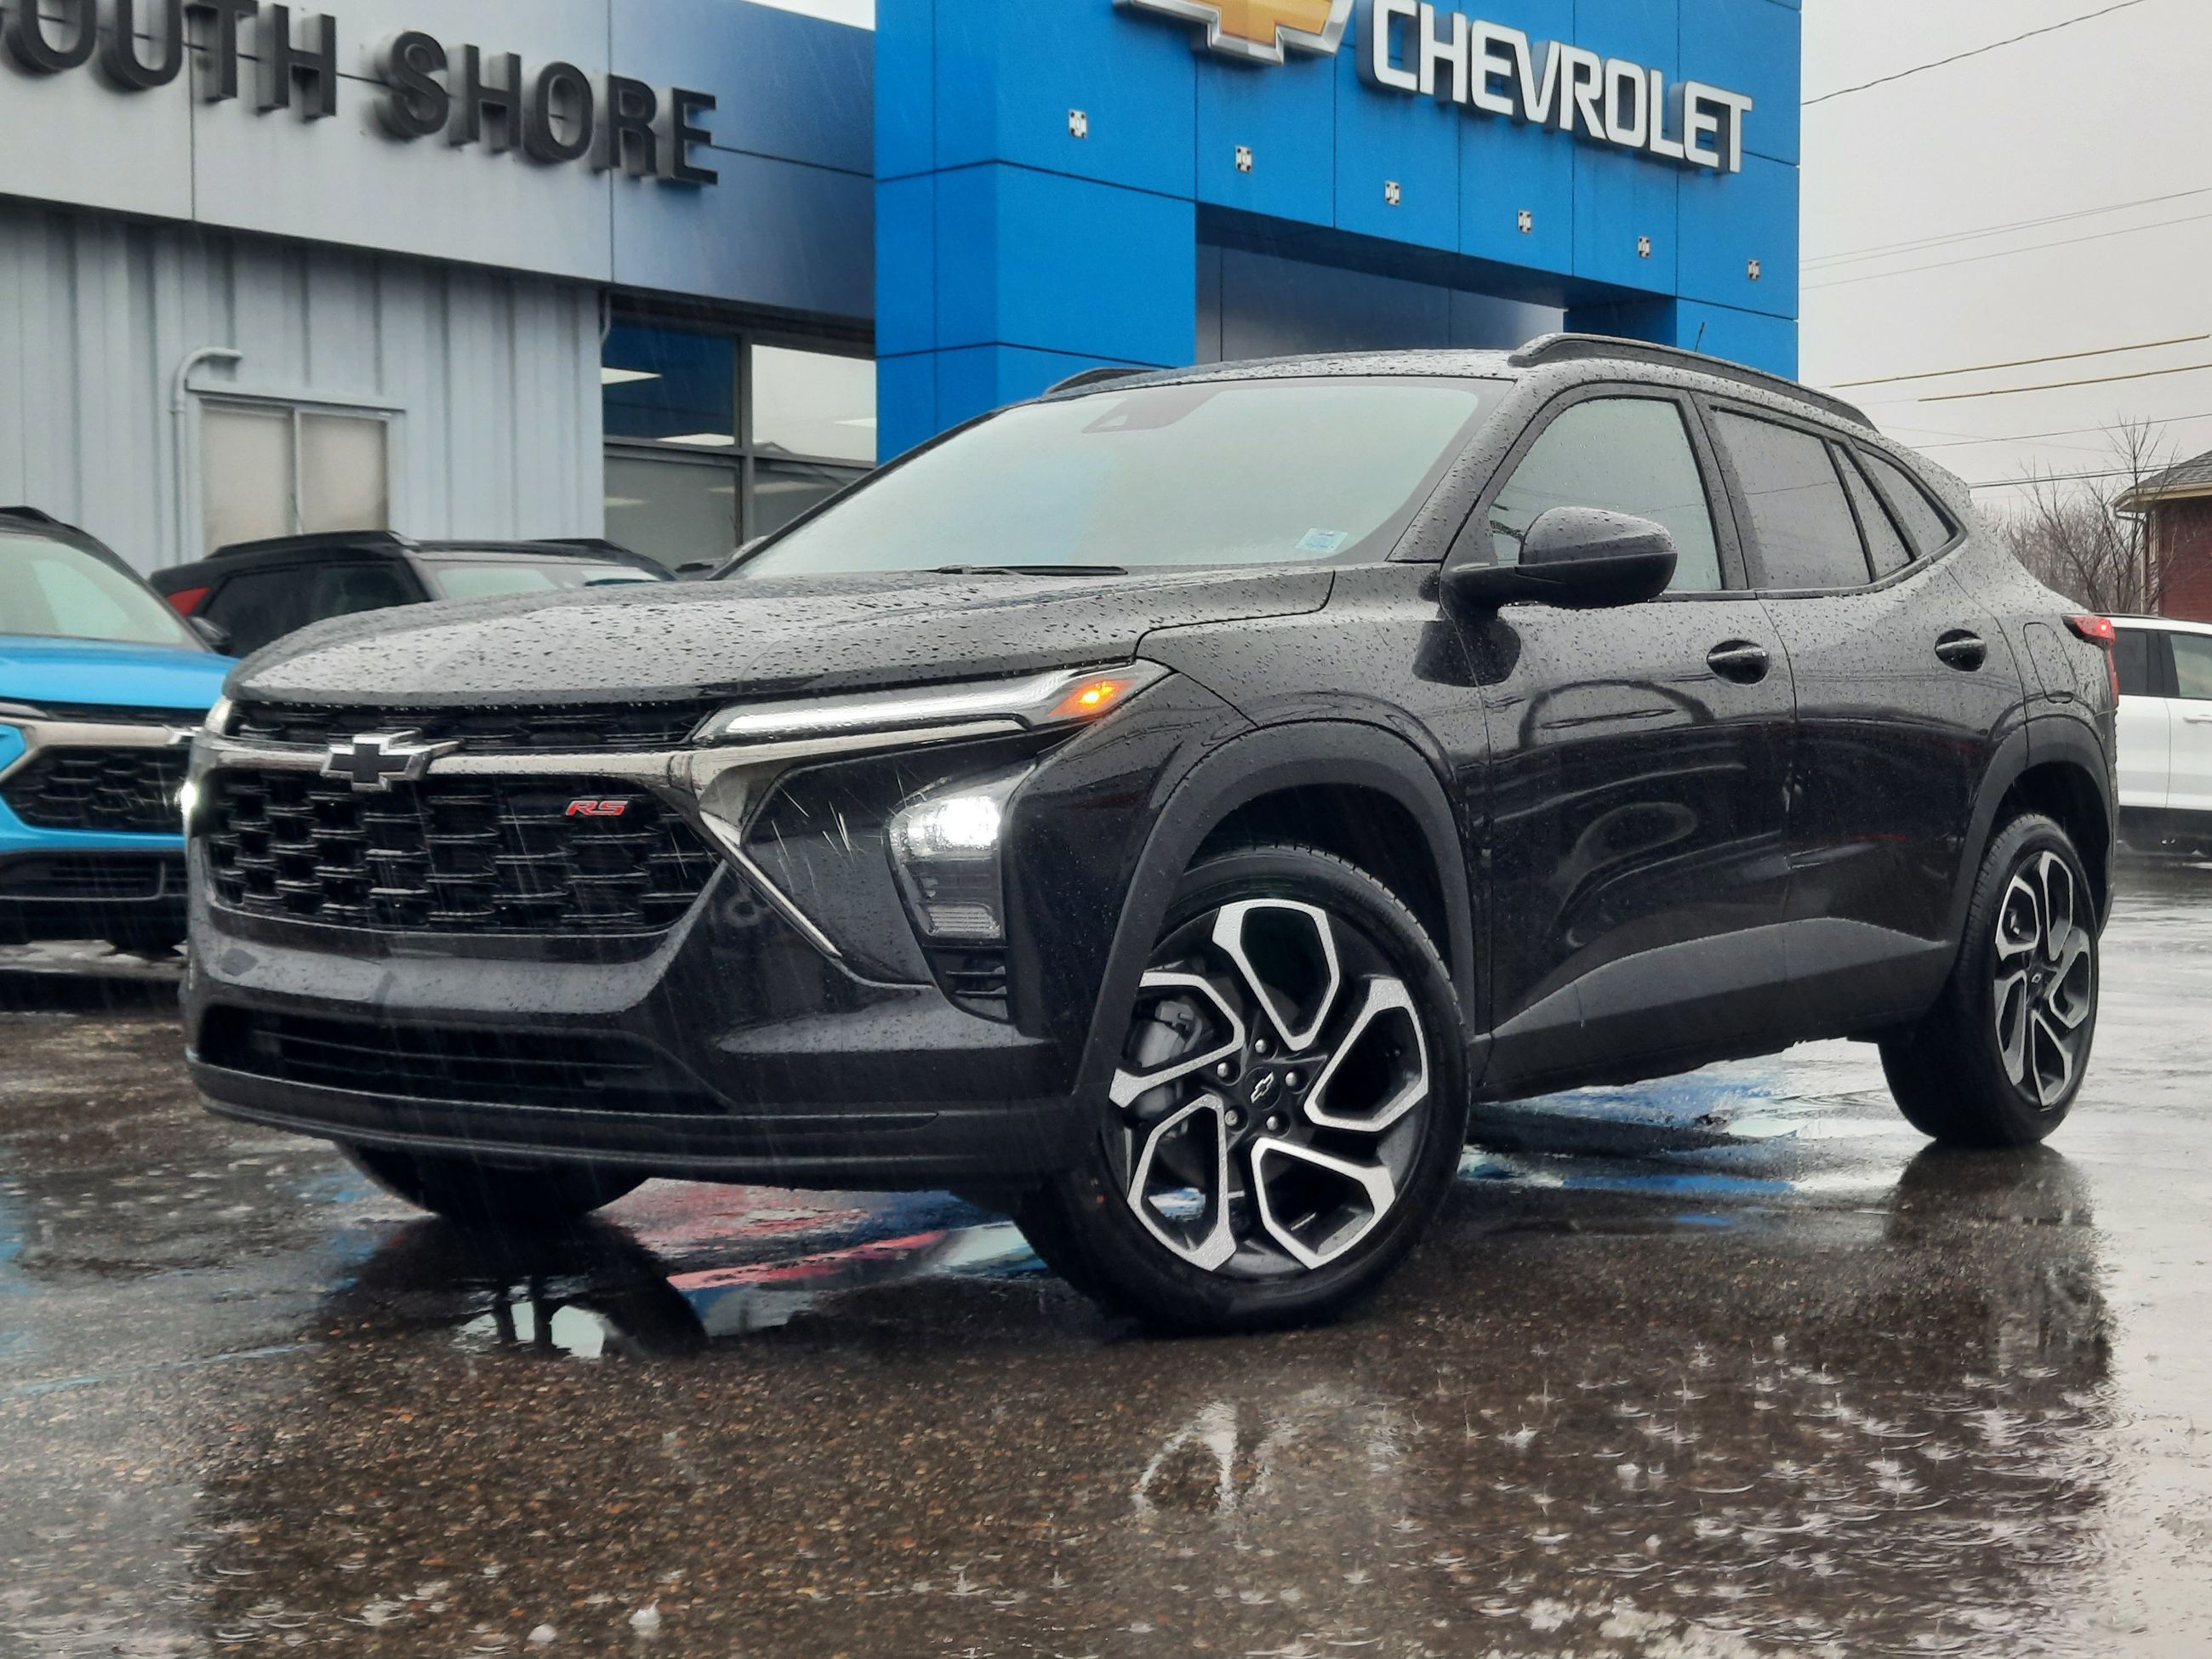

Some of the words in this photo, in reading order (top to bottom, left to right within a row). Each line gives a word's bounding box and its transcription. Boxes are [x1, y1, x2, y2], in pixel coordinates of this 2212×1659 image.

[0, 0, 337, 117] OUTH
[389, 31, 718, 185] SHORE
[1368, 0, 1753, 173] CHEVROLET
[565, 801, 628, 816] RS
